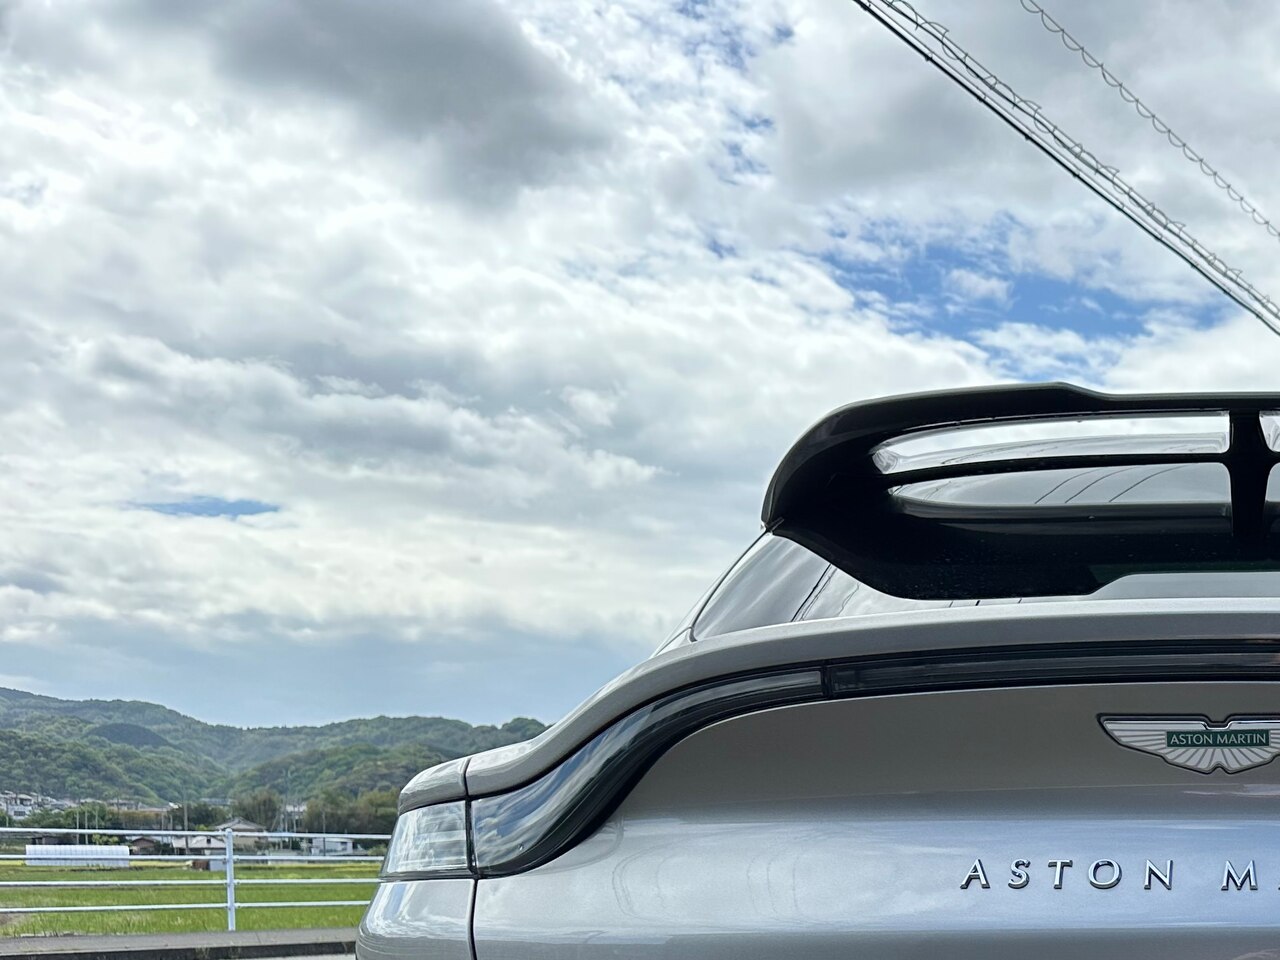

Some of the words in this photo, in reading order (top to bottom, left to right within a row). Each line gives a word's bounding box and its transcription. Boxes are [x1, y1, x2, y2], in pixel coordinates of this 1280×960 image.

[1170, 733, 1213, 745] ASTON
[1217, 732, 1266, 744] MARTIN
[959, 858, 1174, 890] ASTON
